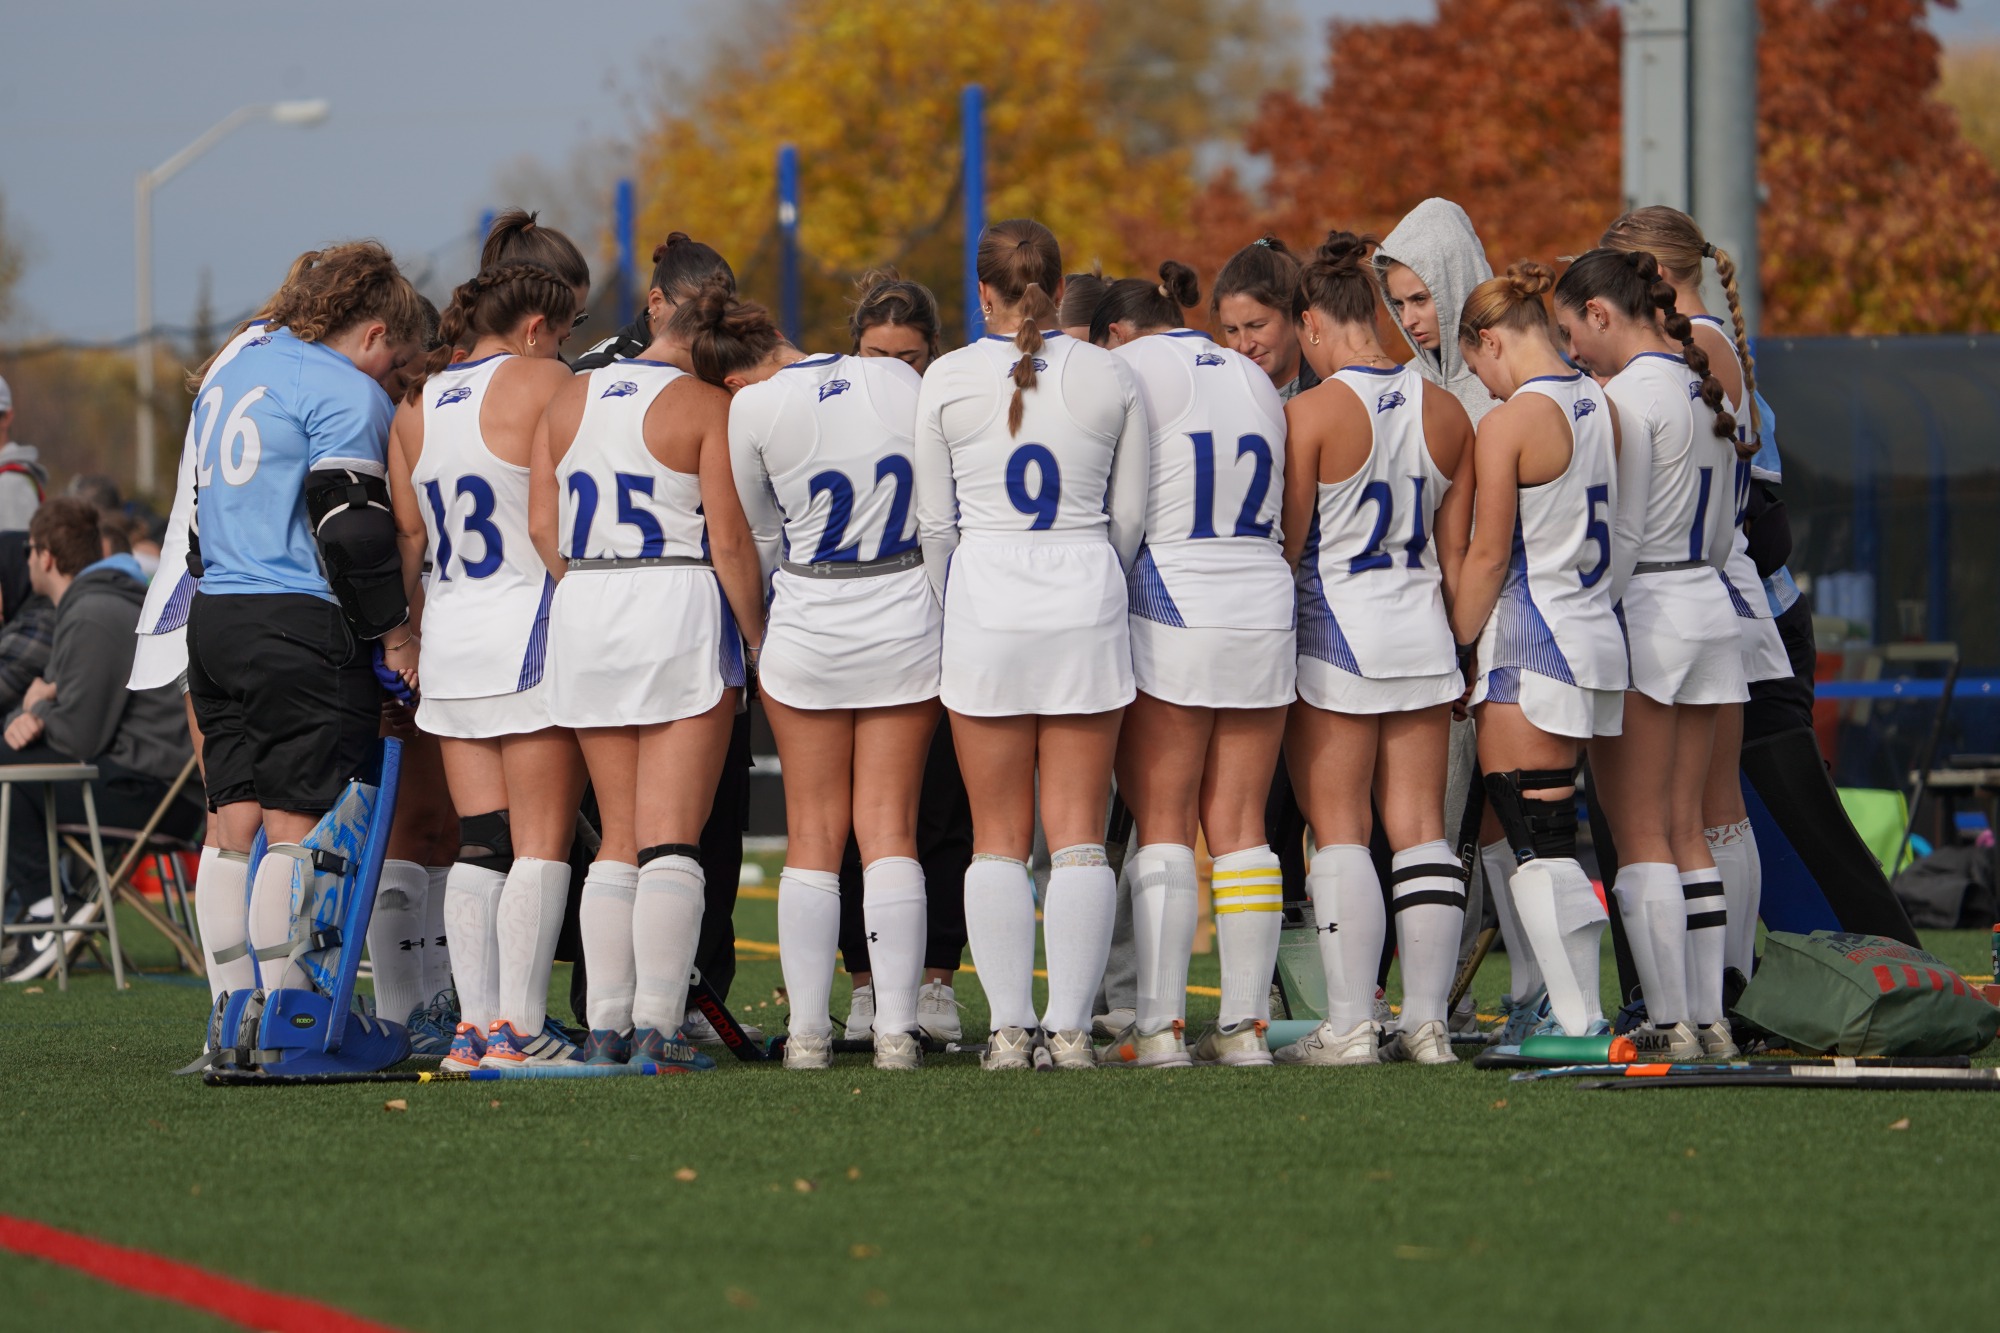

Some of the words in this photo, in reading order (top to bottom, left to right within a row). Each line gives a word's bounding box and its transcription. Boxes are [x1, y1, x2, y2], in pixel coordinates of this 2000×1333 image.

[198, 385, 268, 487] 26
[1005, 442, 1062, 530] 9
[1182, 430, 1275, 538] 12
[419, 473, 505, 583] 13
[567, 469, 666, 559] 25
[808, 452, 919, 564] 22
[1348, 475, 1427, 576] 21
[1577, 482, 1611, 589] 5
[663, 1042, 695, 1061] OSAK
